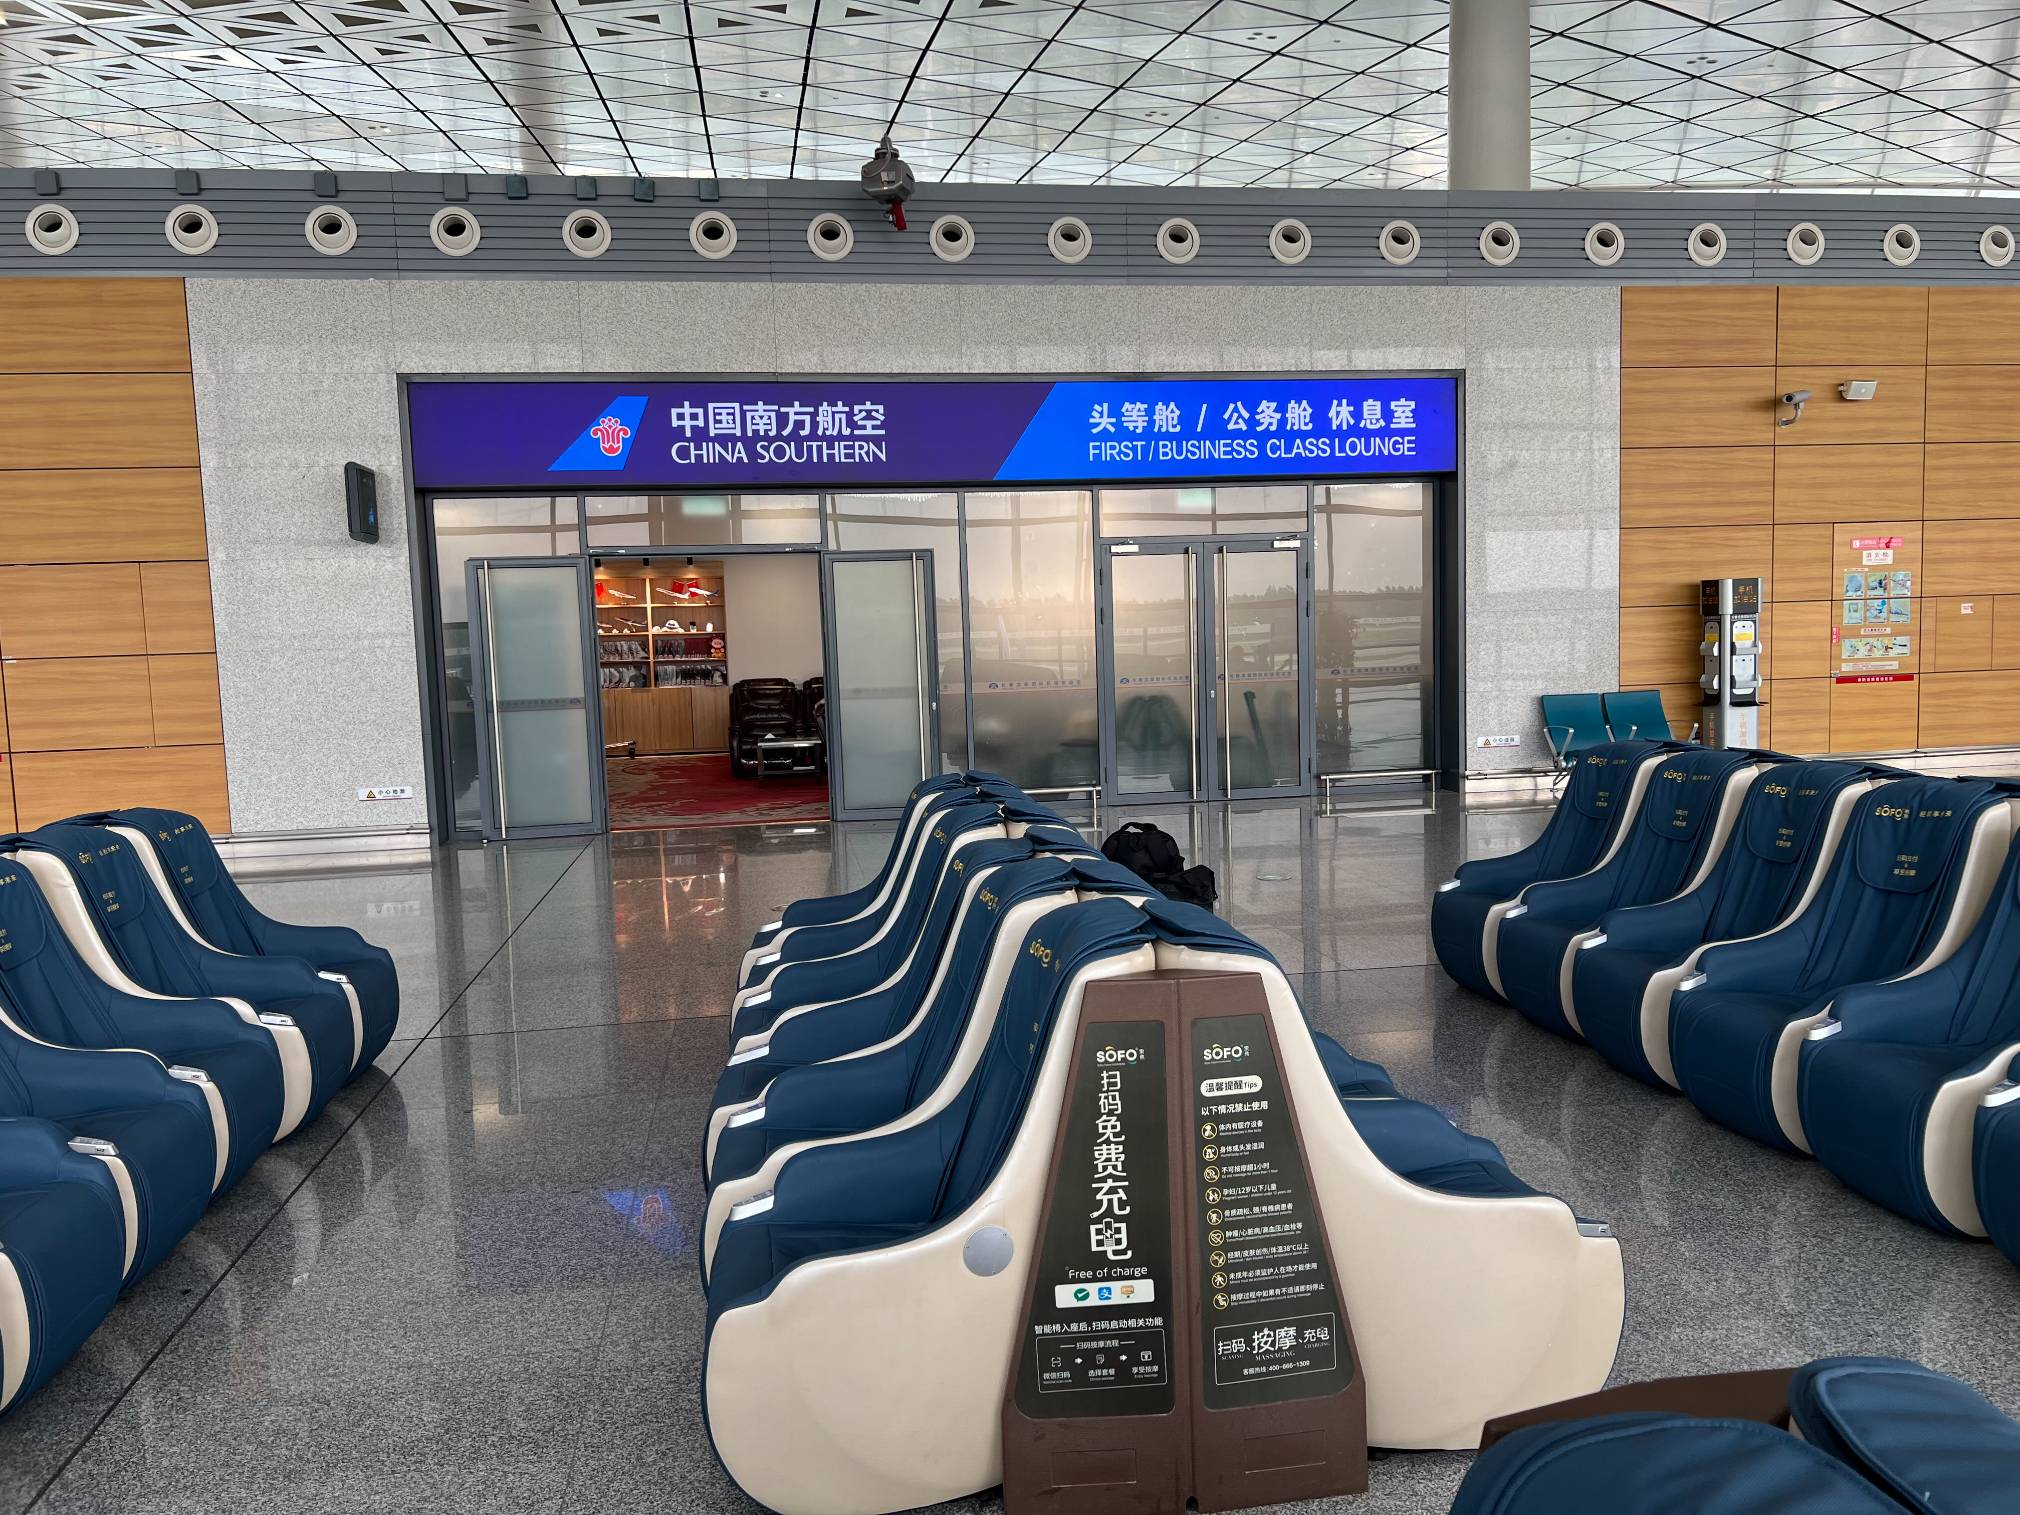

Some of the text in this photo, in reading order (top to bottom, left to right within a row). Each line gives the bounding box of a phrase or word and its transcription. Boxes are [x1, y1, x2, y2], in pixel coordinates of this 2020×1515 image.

[671, 401, 886, 437] 中国南方航空
[1088, 401, 1181, 434] 头等舱
[1222, 399, 1313, 432] 公务舱
[1328, 398, 1417, 430] 休息室
[671, 441, 887, 464] CHINA SOUTHERN
[1266, 437, 1331, 459] CLASS
[1335, 436, 1417, 457] LOUNGE
[1201, 1100, 1269, 1116] 以下情况禁止使用
[1089, 1070, 1132, 1260] 扫码免费充电
[1068, 1266, 1148, 1279] Free of charge
[1076, 1339, 1120, 1350] 扫码按摩流程
